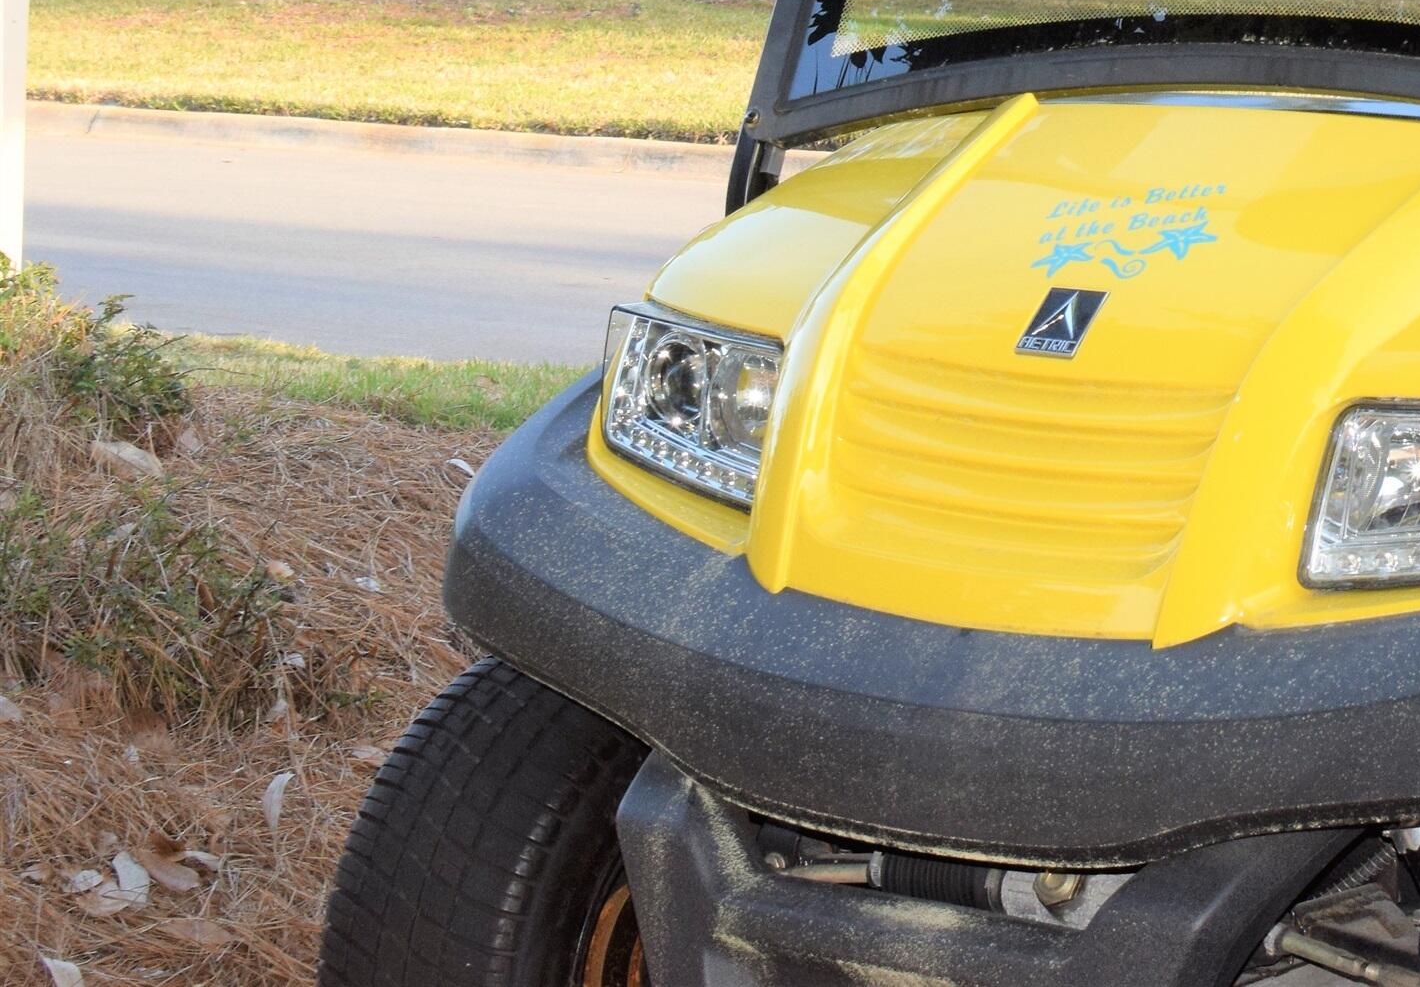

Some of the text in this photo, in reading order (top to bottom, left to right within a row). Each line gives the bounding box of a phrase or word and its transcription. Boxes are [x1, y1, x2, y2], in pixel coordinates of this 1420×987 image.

[1045, 183, 1227, 219] Life is Better
[1039, 206, 1208, 244] at the Beach
[1018, 336, 1077, 354] AETRIC
